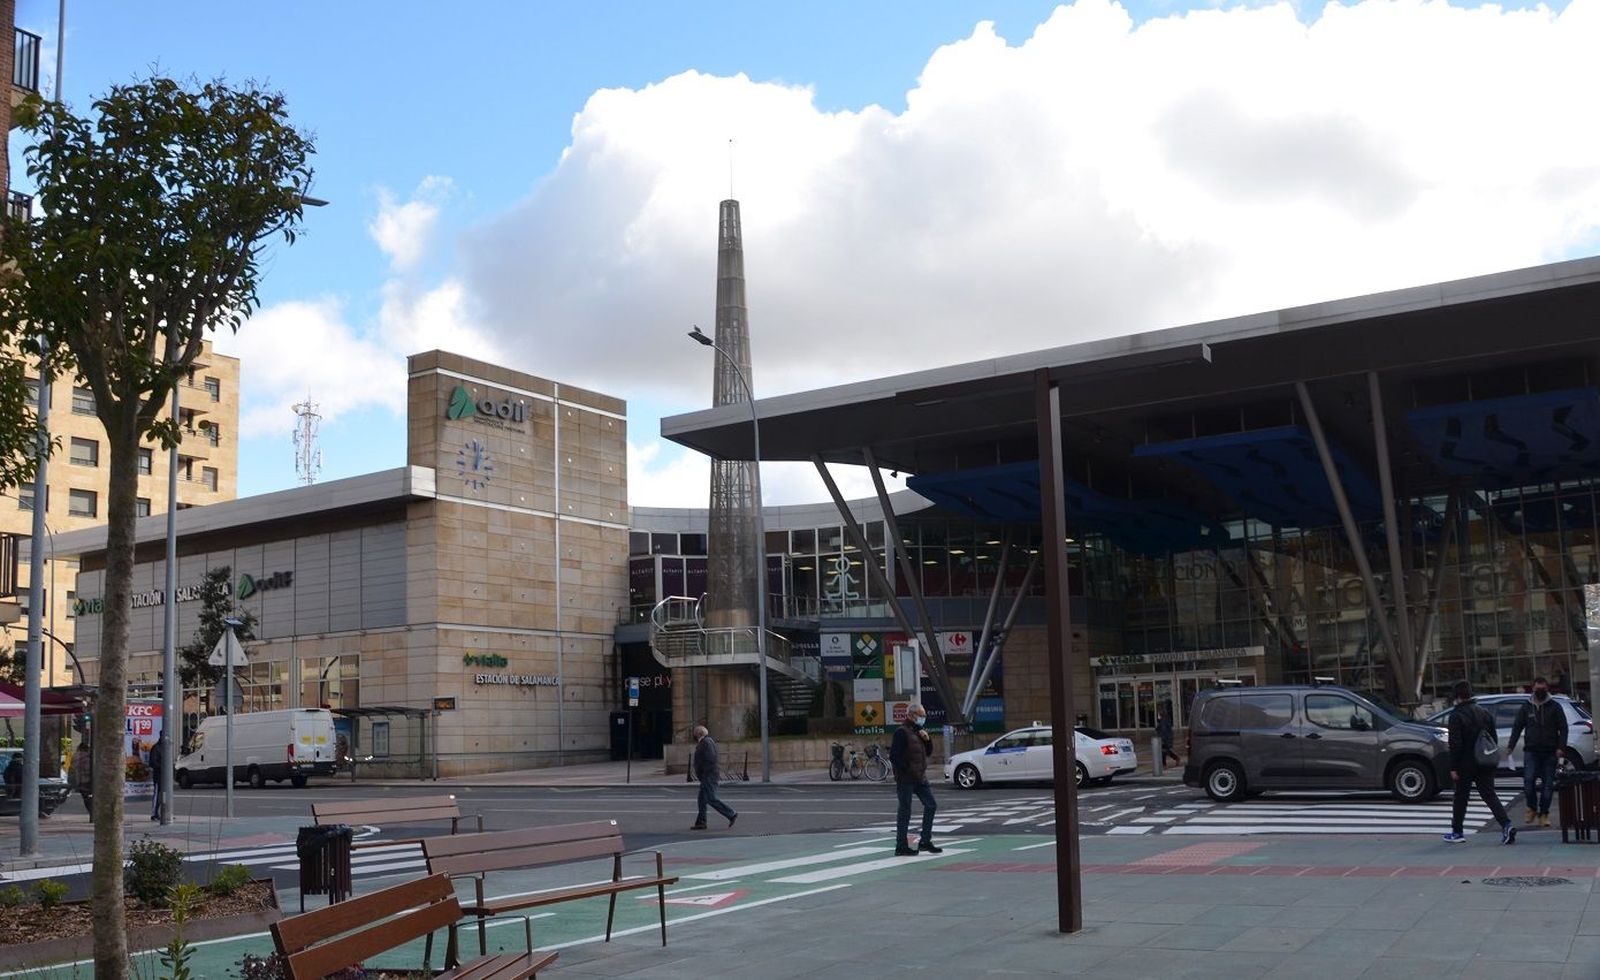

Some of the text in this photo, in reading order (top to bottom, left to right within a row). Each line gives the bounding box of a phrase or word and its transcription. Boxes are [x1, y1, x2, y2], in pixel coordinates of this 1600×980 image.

[130, 589, 161, 609] TACIÓN
[84, 598, 105, 616] via
[475, 673, 560, 687] ESTACIÓN DE SALAMANCA
[128, 705, 153, 716] KFC
[854, 726, 885, 735] vialia
